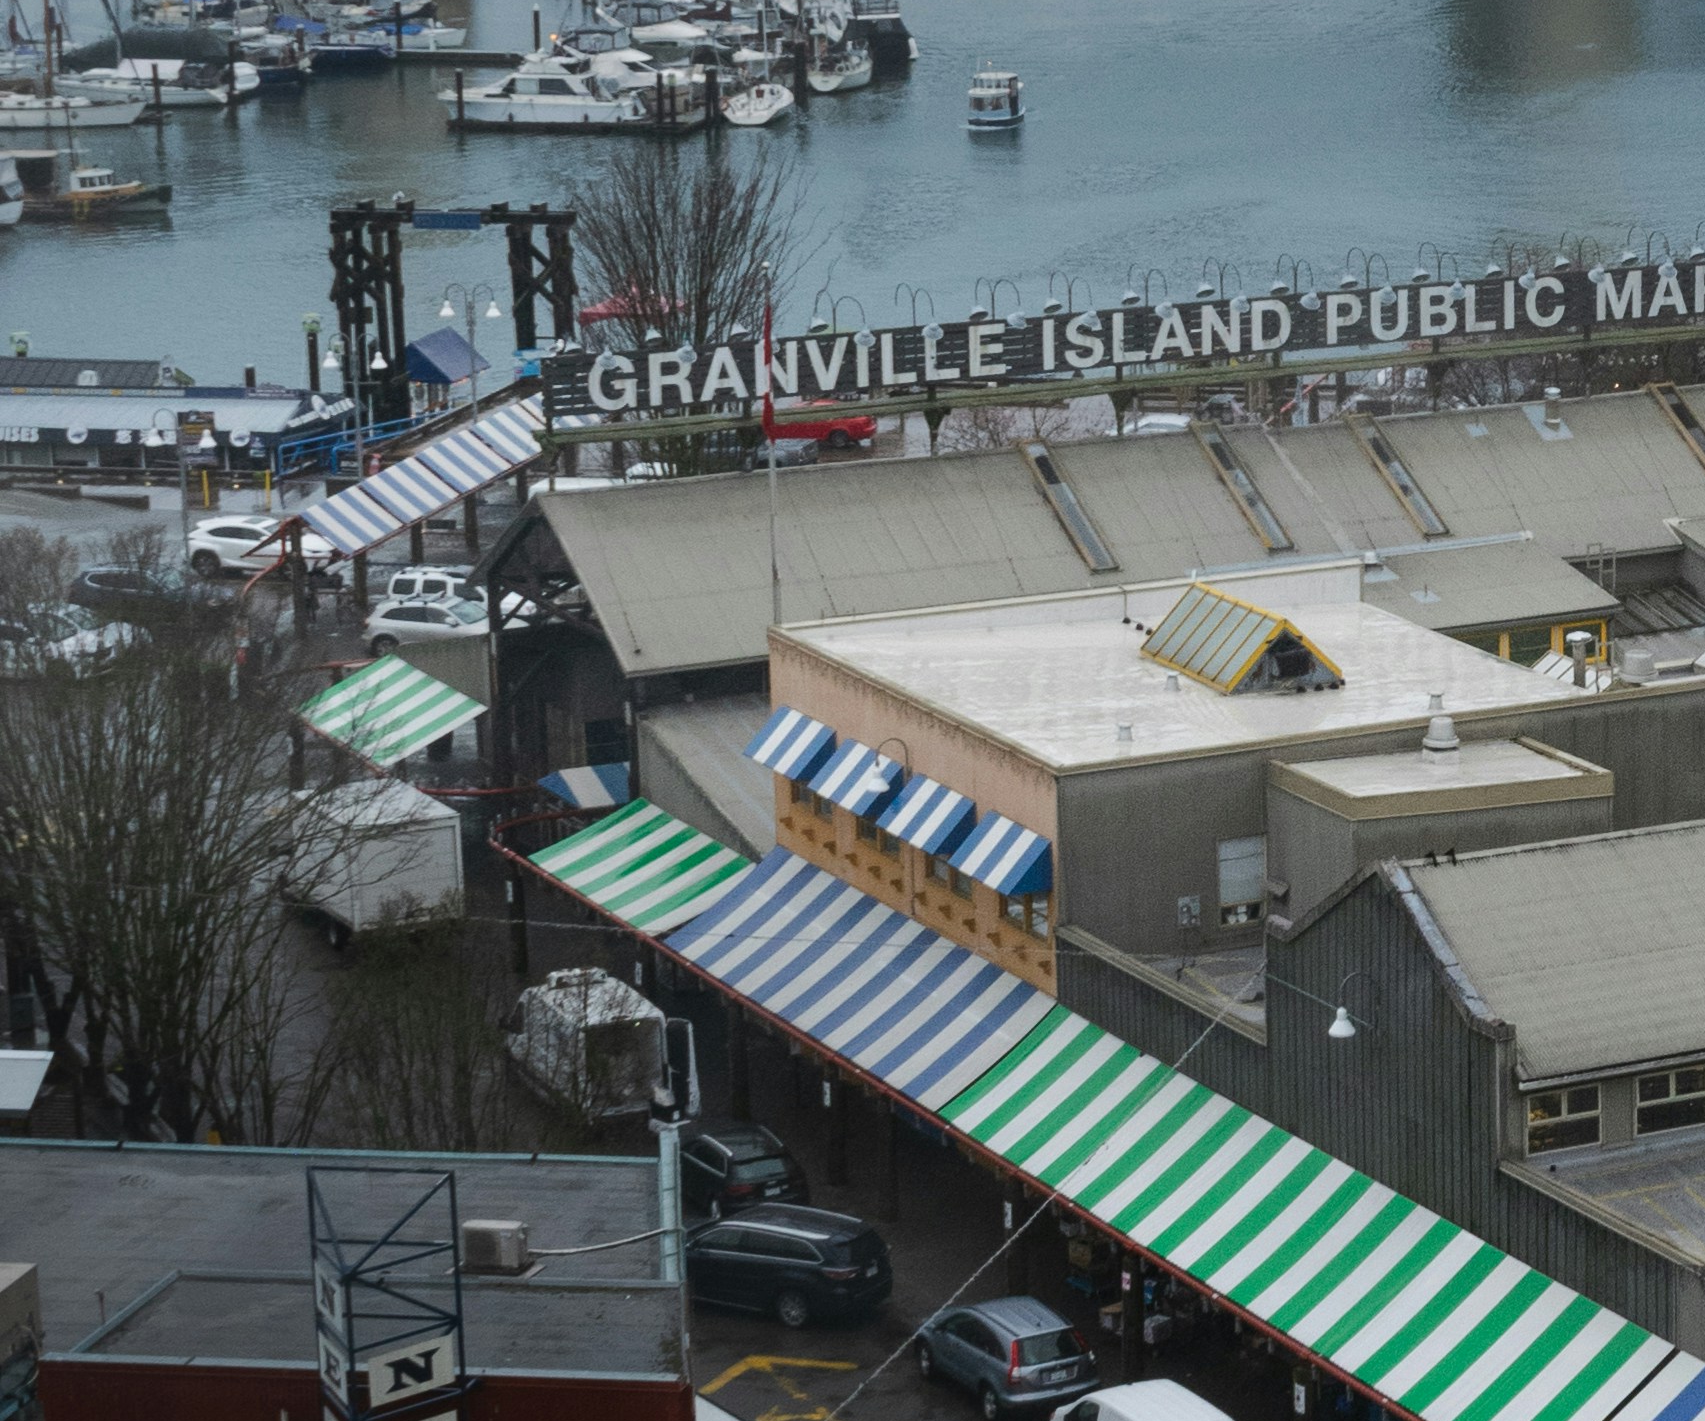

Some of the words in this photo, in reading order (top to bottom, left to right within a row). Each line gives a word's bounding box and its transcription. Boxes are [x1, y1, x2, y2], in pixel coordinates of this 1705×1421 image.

[587, 322, 1007, 411] GRANVILLE
[1042, 298, 1292, 371] ISLAND
[1325, 276, 1566, 346] PUBLIC
